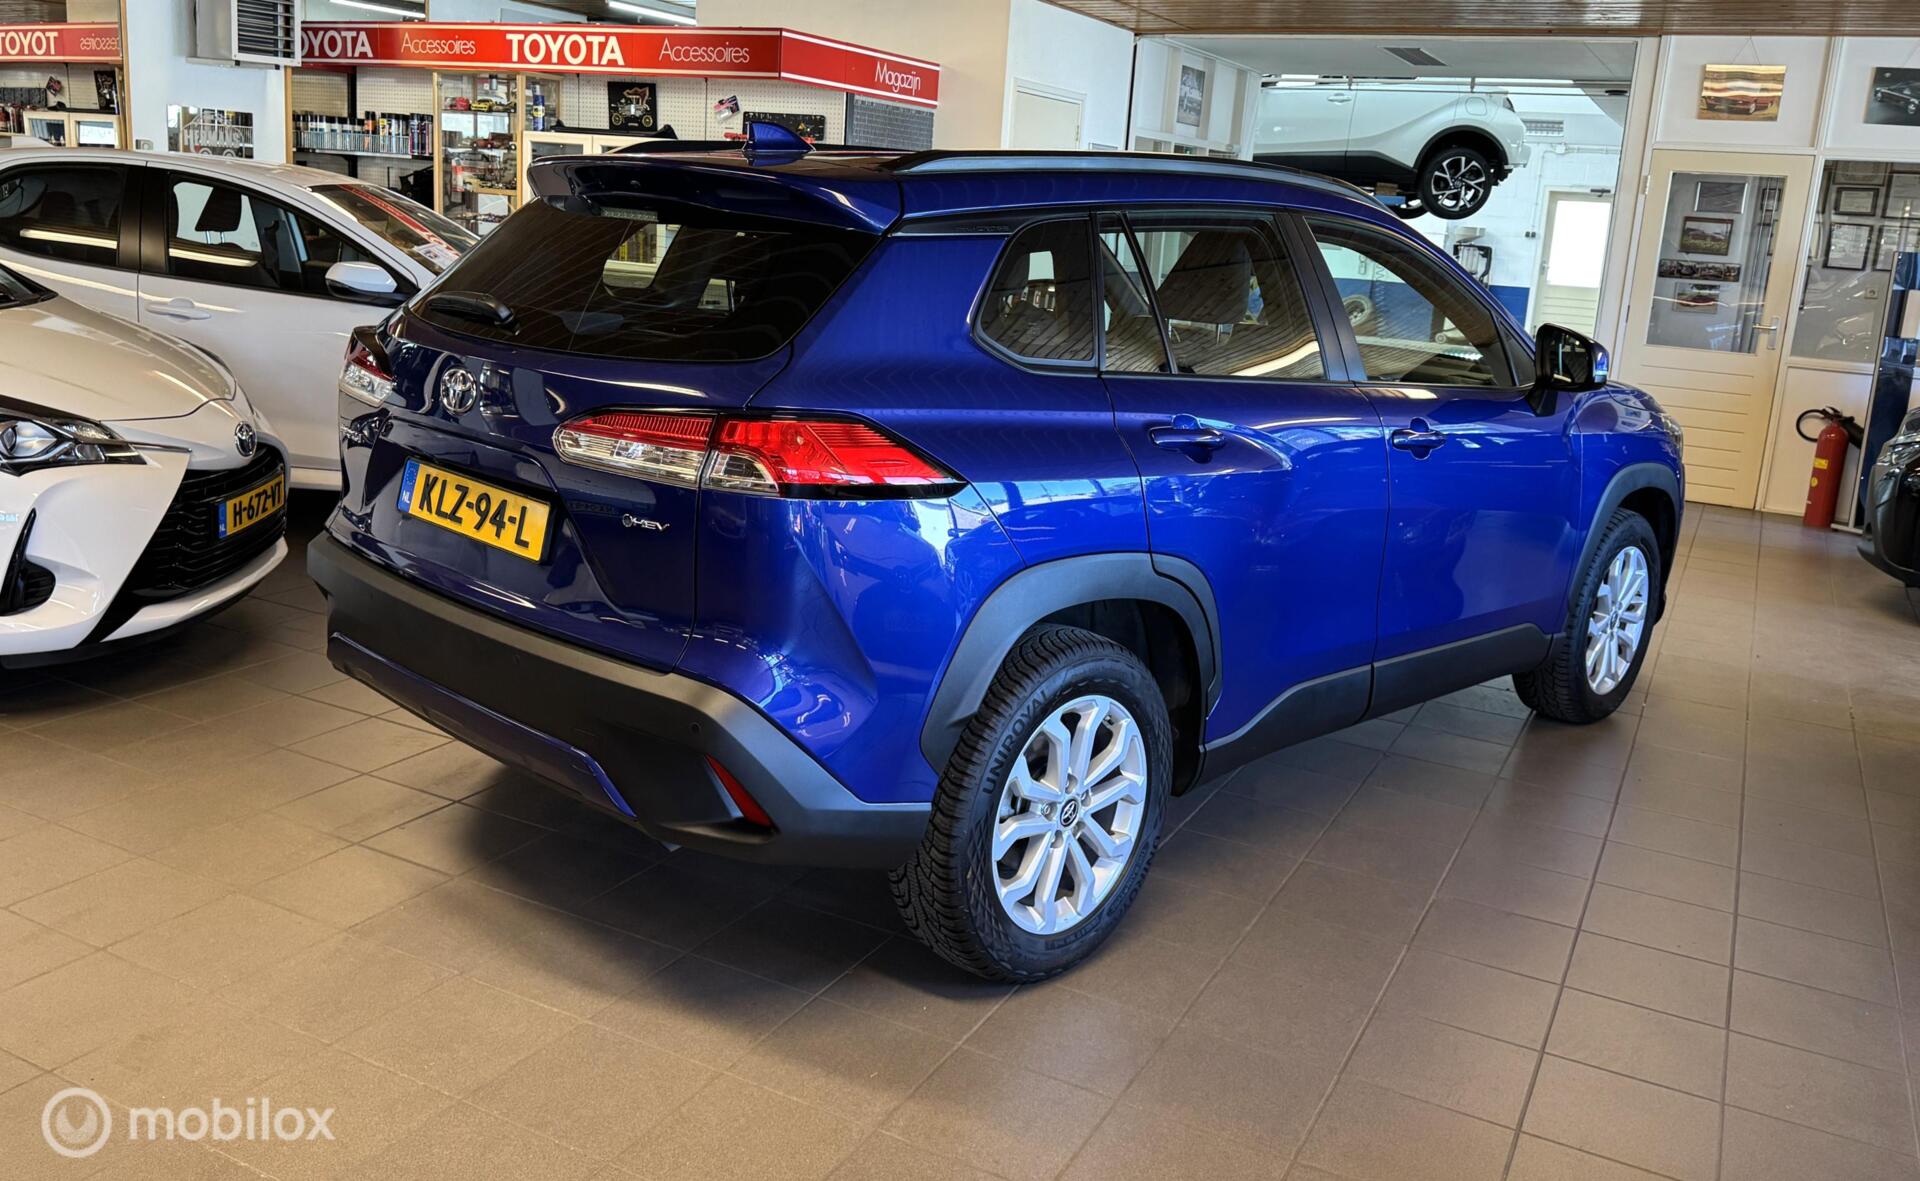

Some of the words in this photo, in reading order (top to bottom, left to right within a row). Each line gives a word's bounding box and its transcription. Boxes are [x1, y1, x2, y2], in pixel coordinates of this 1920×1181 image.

[401, 32, 476, 55] Accessoires
[506, 33, 625, 66] TOYOTA
[659, 38, 750, 64] Accessoires
[874, 60, 921, 96] Magazijn
[233, 480, 283, 529] H-672-VT
[401, 490, 410, 504] NL
[418, 473, 530, 549] KLZ-94-L
[982, 689, 1049, 795] UNIROYAL
